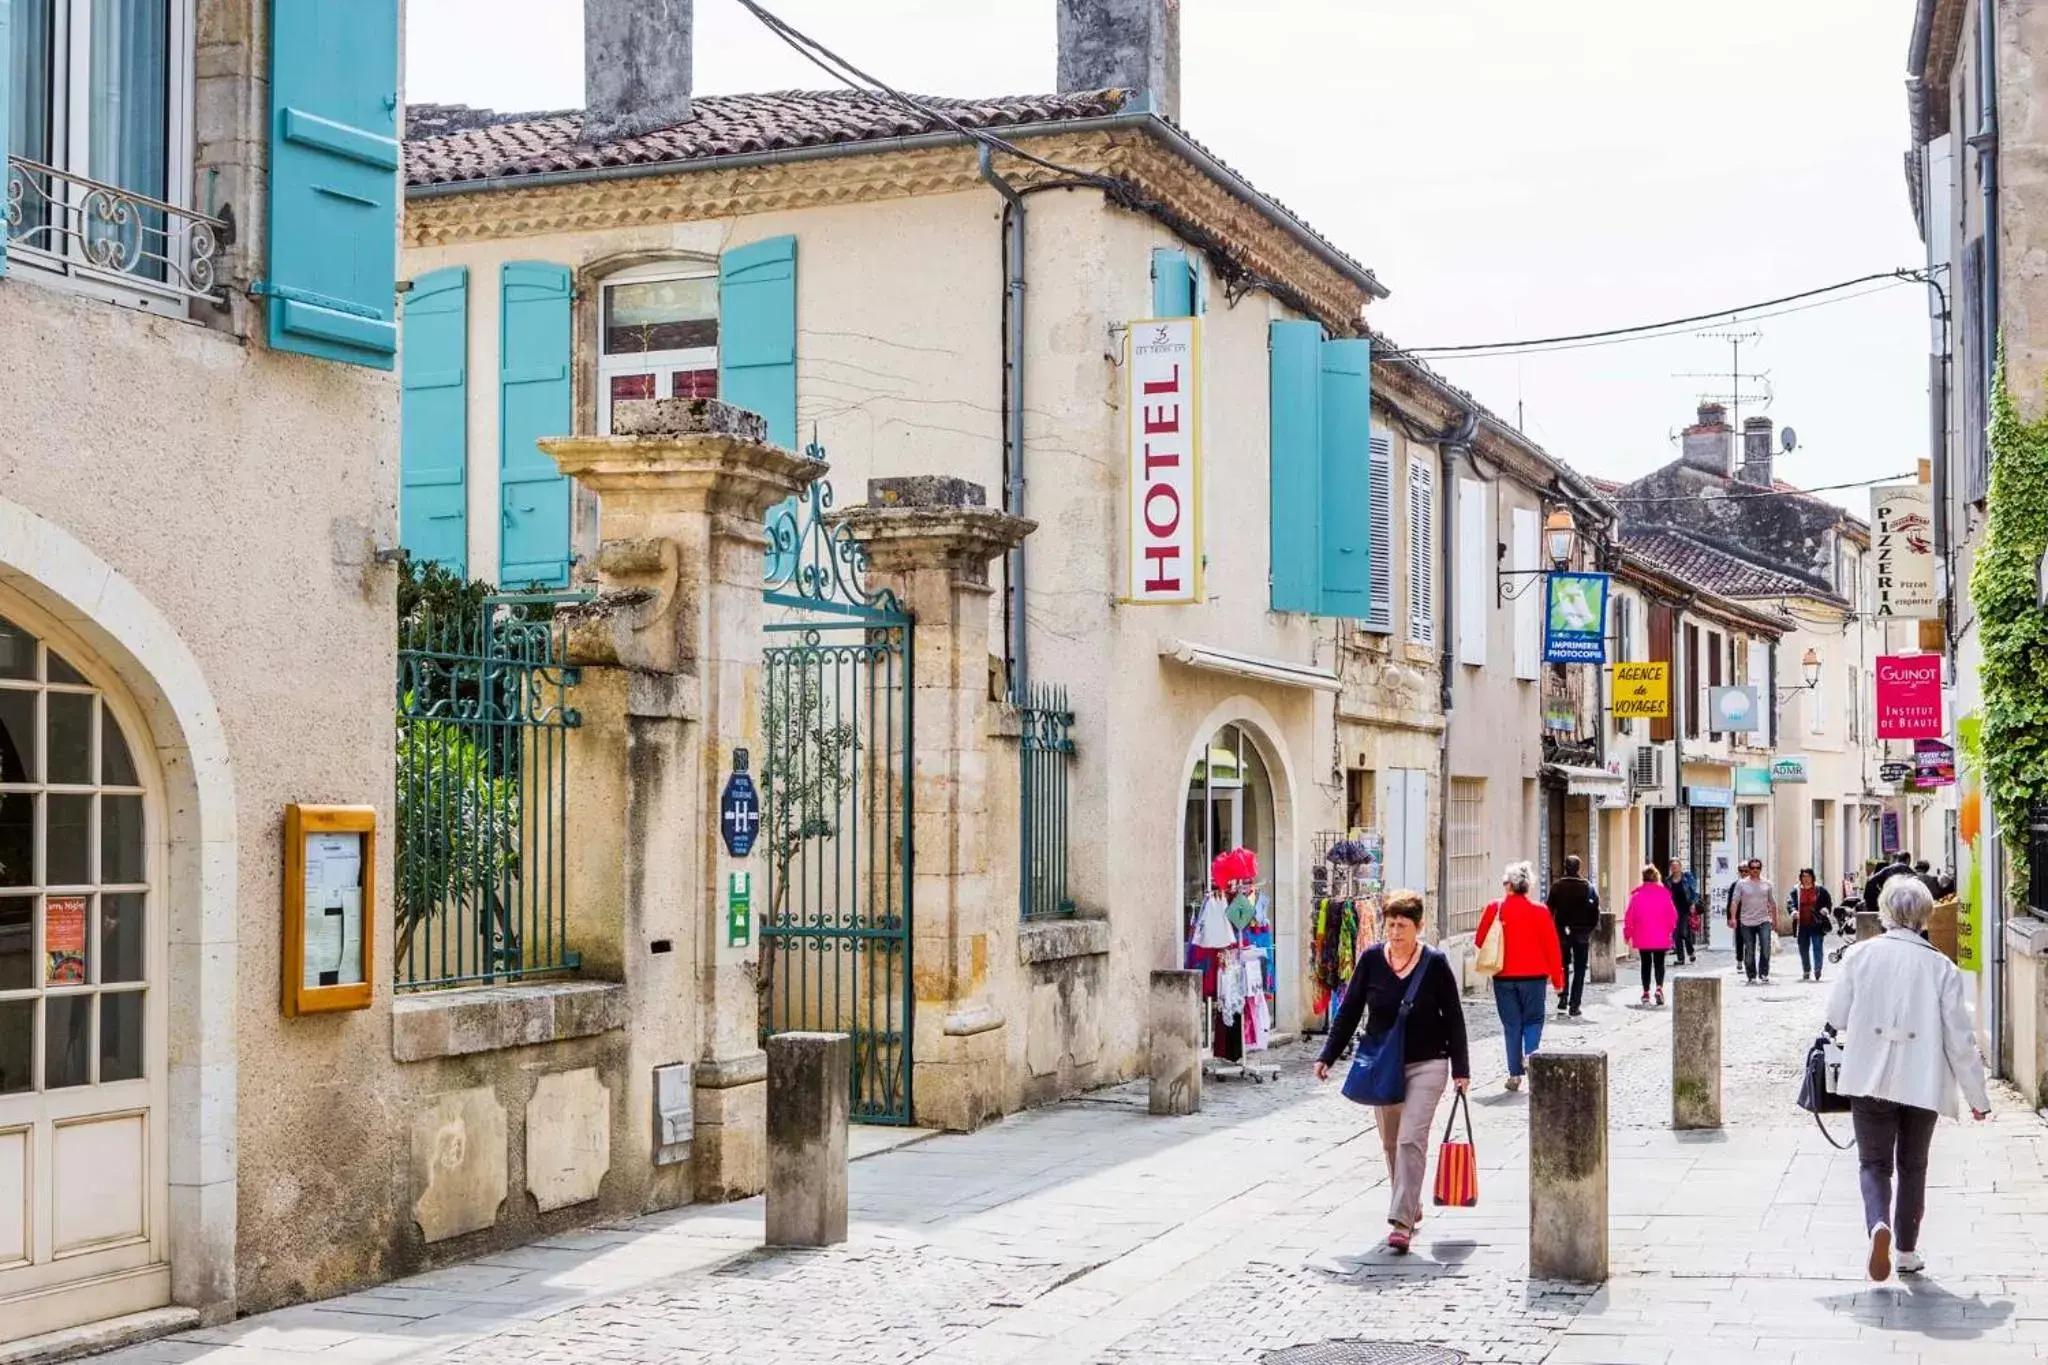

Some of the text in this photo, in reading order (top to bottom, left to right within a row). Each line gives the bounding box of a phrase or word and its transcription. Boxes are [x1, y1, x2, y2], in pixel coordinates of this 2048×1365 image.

[1143, 364, 1181, 592] HOTEL
[1877, 507, 1893, 616] PIZZERIA
[1551, 641, 1600, 650] IMPRIMERIE
[1617, 667, 1663, 681] AGENCE
[1880, 665, 1937, 681] GUINOT
[1633, 685, 1648, 695] de
[1615, 700, 1665, 713] VOYAGES
[1886, 705, 1934, 716] INSTITUT
[1881, 720, 1894, 729] DE
[1773, 766, 1803, 775] ADMR
